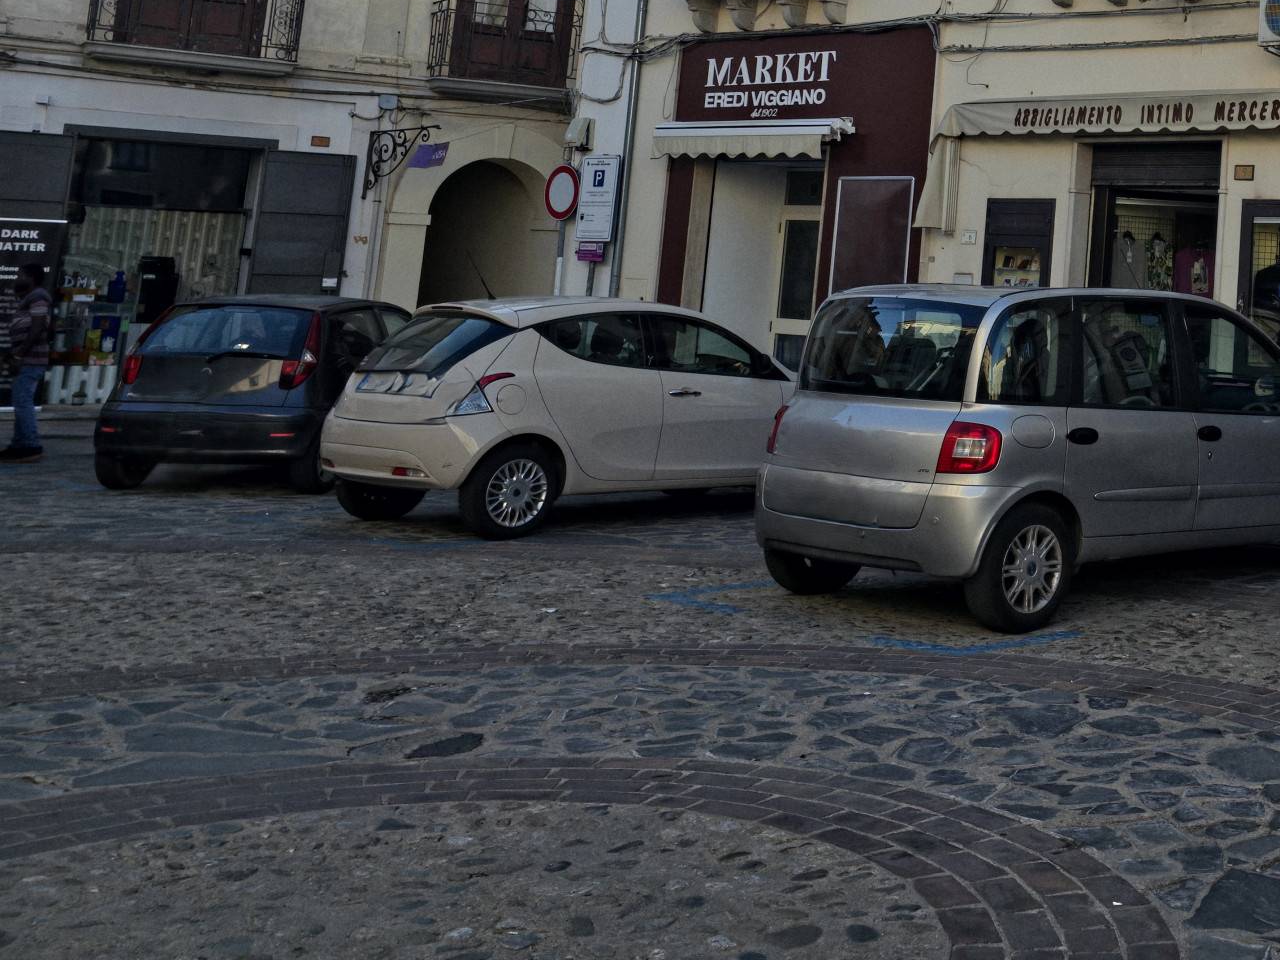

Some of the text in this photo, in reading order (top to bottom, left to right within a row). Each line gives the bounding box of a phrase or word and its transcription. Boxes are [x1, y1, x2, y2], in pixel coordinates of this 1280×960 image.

[704, 50, 837, 87] MARKET
[704, 88, 826, 108] EREDI VIGGIANO
[760, 108, 778, 118] 1902
[1014, 105, 1123, 127] ABBIGLIAMENTO
[1140, 102, 1194, 125] INTIMO
[1, 229, 39, 239] DARK
